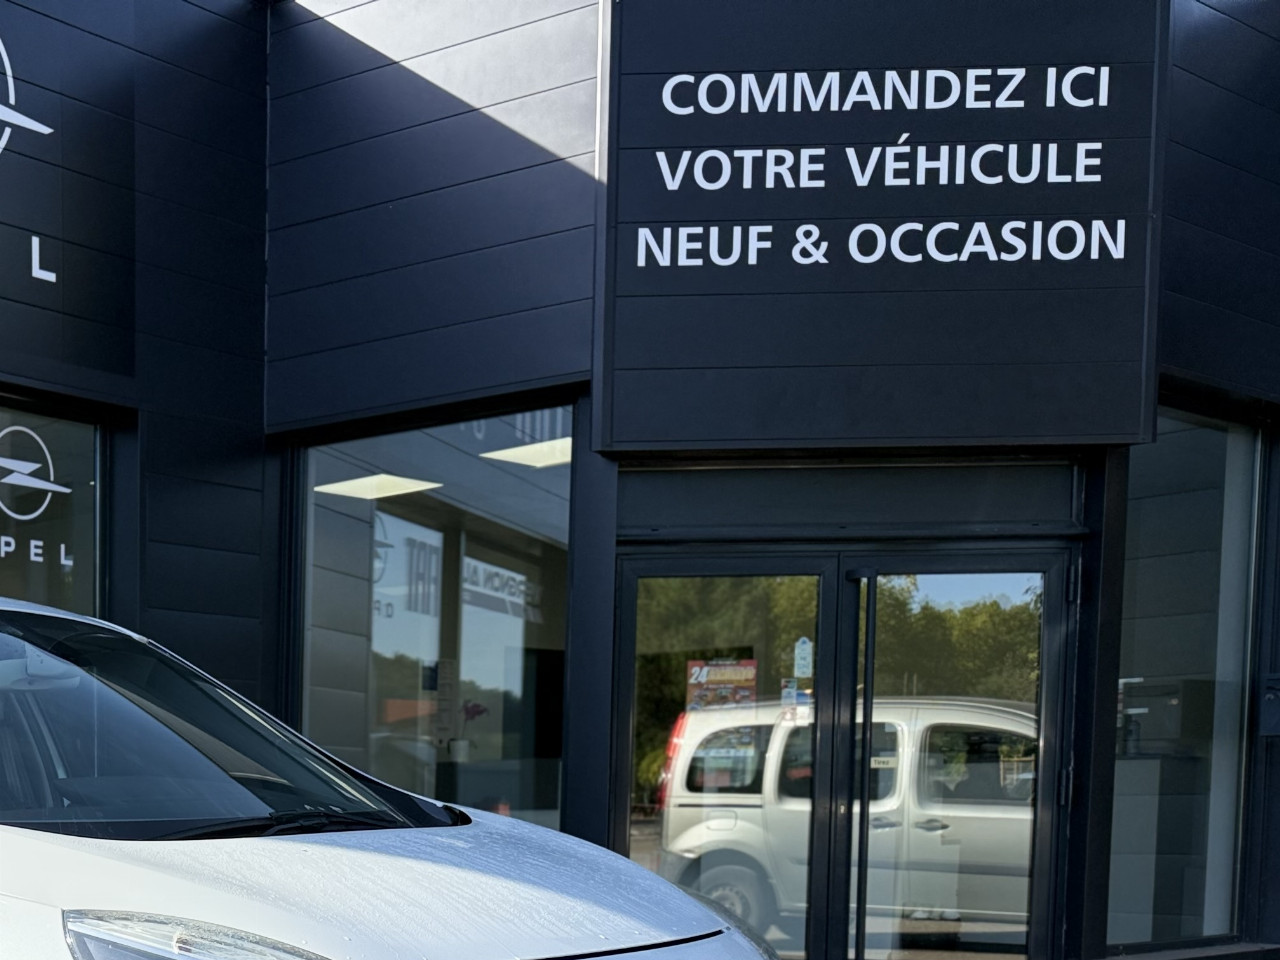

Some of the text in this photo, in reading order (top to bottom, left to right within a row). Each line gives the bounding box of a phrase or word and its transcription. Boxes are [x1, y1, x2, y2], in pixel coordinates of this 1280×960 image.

[662, 66, 1110, 115] COMMANDEZ ICI
[656, 133, 1102, 190] VOTRE VÉHICULE
[637, 220, 1126, 267] NEUF & OCCASION
